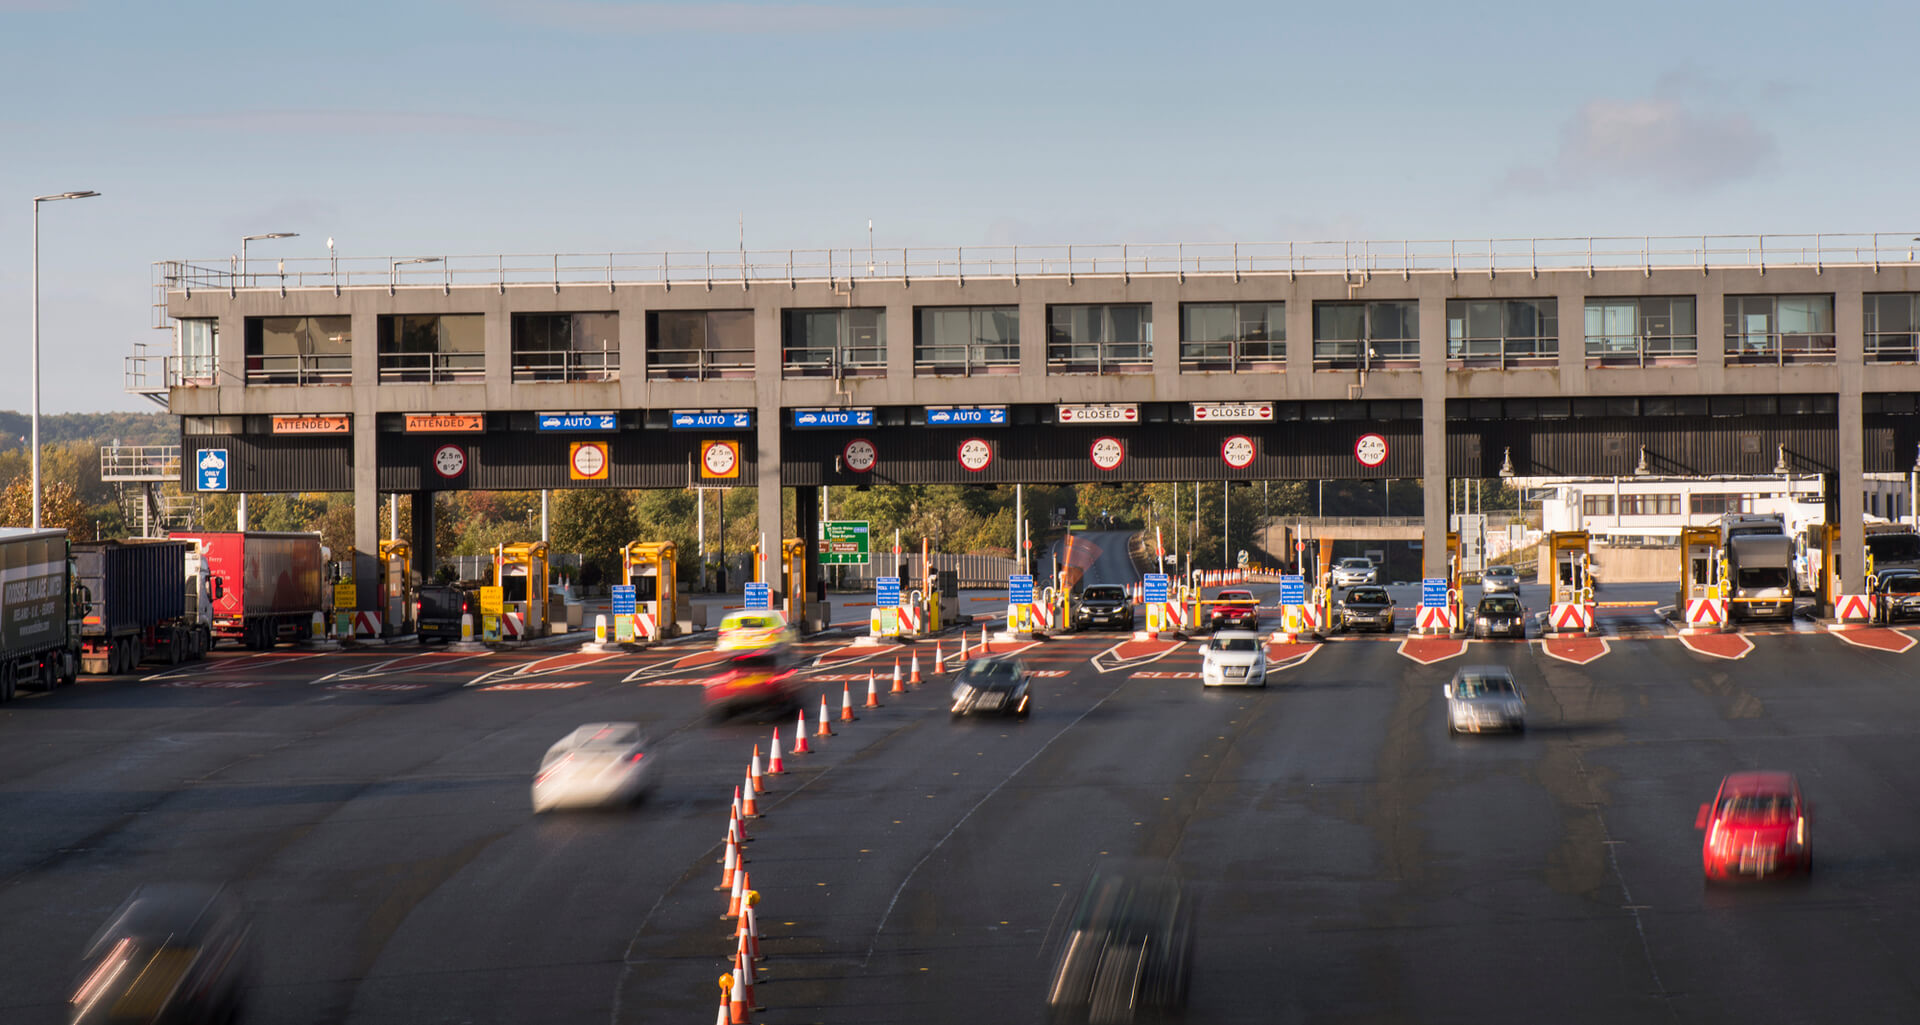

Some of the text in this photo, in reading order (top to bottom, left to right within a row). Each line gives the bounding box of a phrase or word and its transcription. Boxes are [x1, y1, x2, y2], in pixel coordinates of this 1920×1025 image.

[953, 412, 982, 421] AUTO
[1077, 410, 1120, 419] CLOSED
[1212, 408, 1254, 417] CLOSED
[564, 418, 592, 426] AUTO
[697, 416, 725, 424] AUTO
[820, 414, 848, 423] AUTO
[276, 421, 330, 429] ATTENDED
[410, 420, 464, 428] ATTENDED
